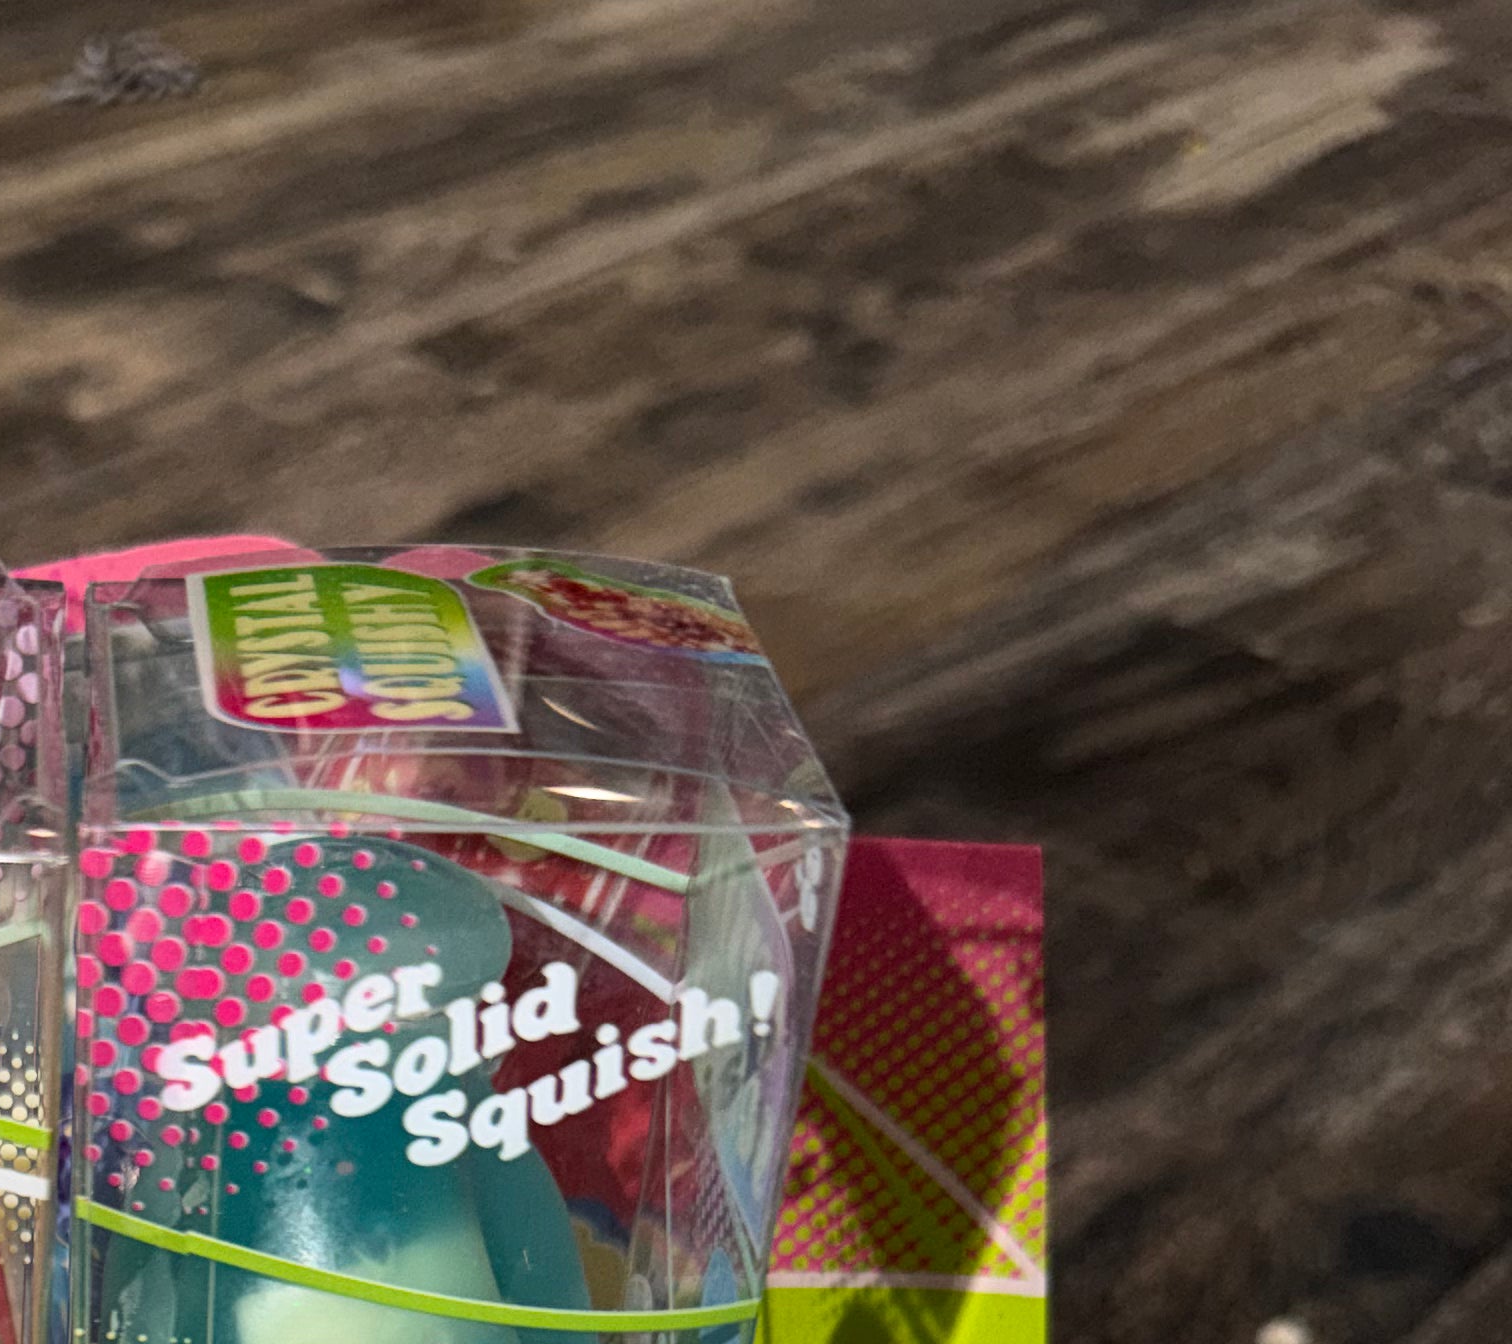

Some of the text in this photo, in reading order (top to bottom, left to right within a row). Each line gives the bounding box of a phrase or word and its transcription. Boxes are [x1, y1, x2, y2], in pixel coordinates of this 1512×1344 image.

[229, 574, 346, 719] CRYSTAL
[342, 582, 475, 720] SQUISHY
[157, 961, 442, 1111] Super
[324, 962, 580, 1116] Solid
[403, 970, 779, 1167] Squish!
